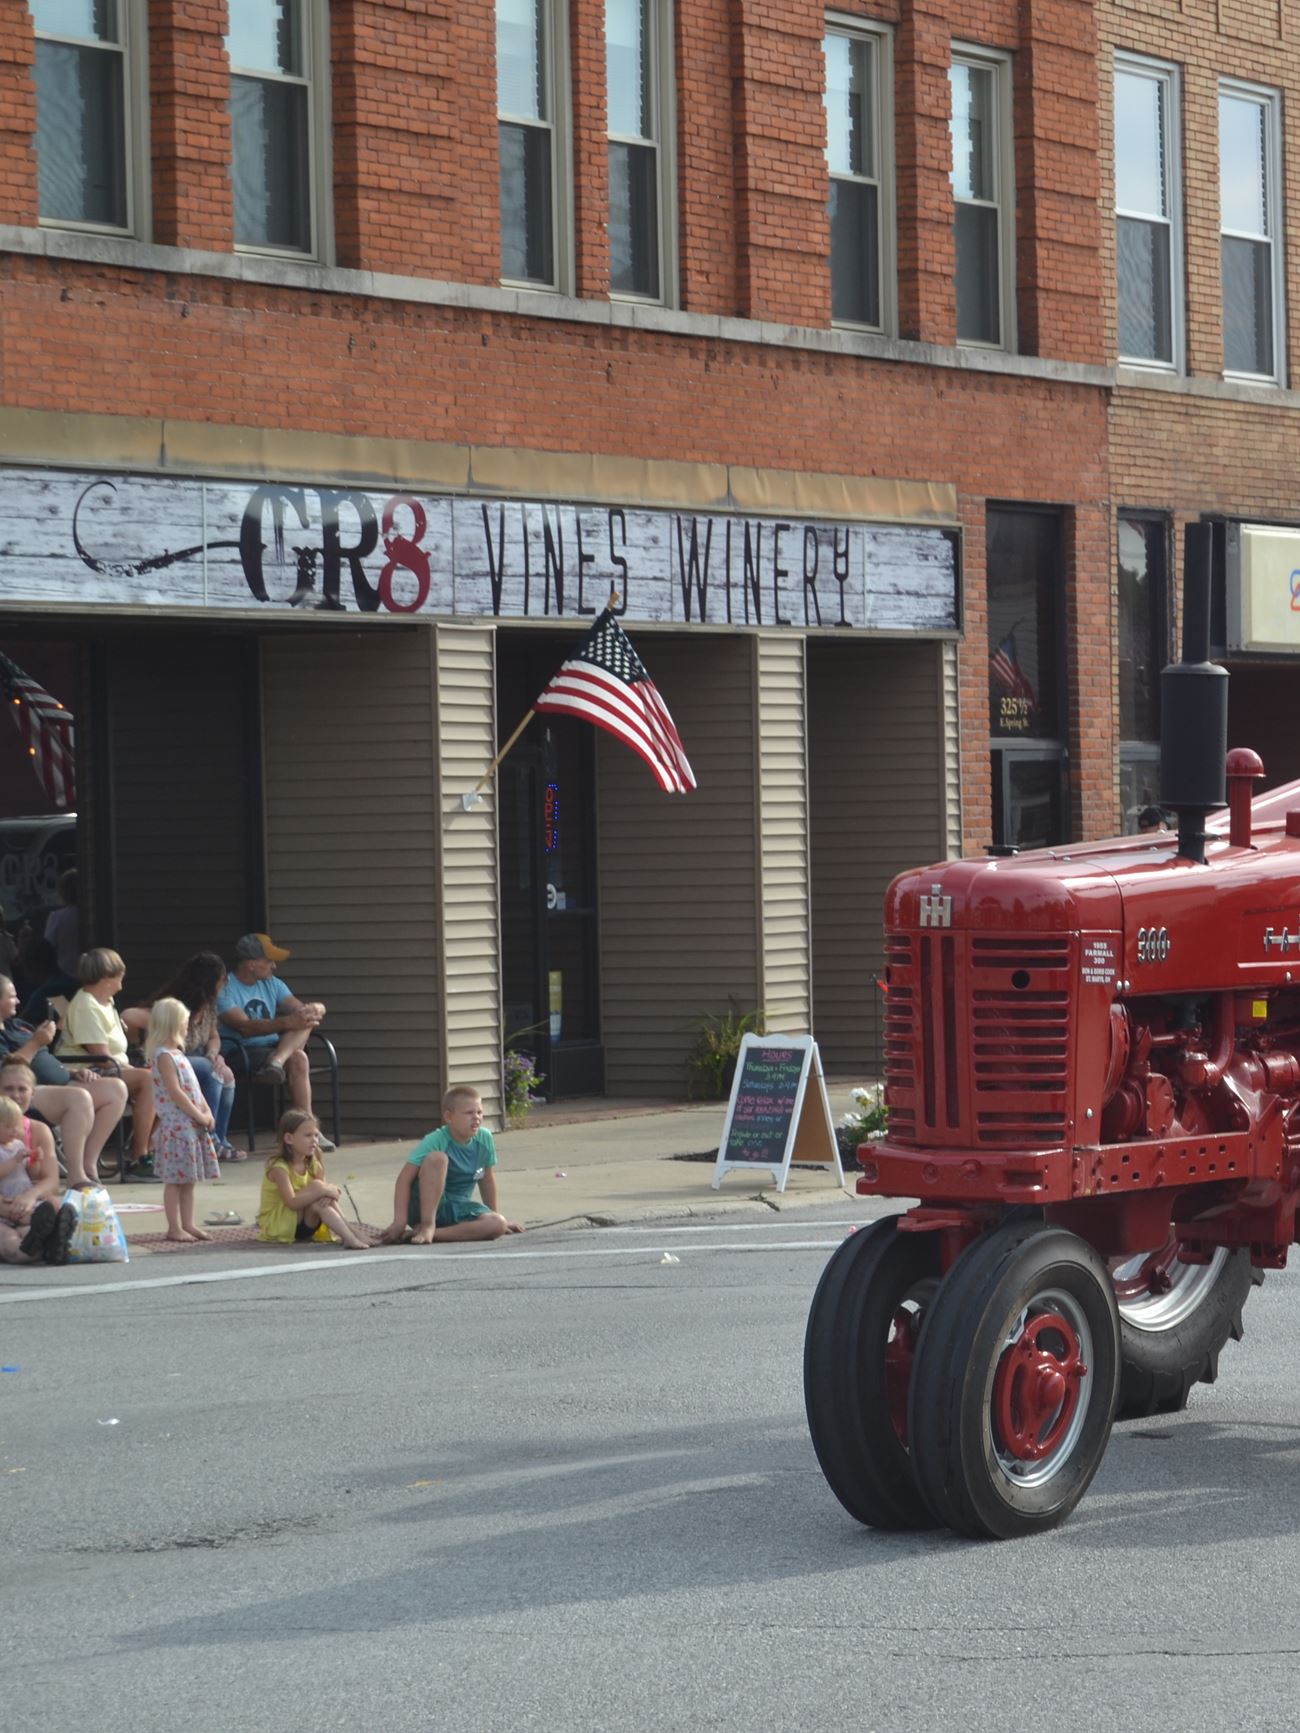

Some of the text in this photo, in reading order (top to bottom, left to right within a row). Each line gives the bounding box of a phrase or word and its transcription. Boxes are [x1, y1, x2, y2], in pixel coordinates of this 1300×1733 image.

[239, 485, 853, 627] GR8 VINES WINERY
[1001, 697, 1018, 715] 325
[1085, 949, 1114, 957] FARMALL
[1138, 927, 1170, 962] 300
